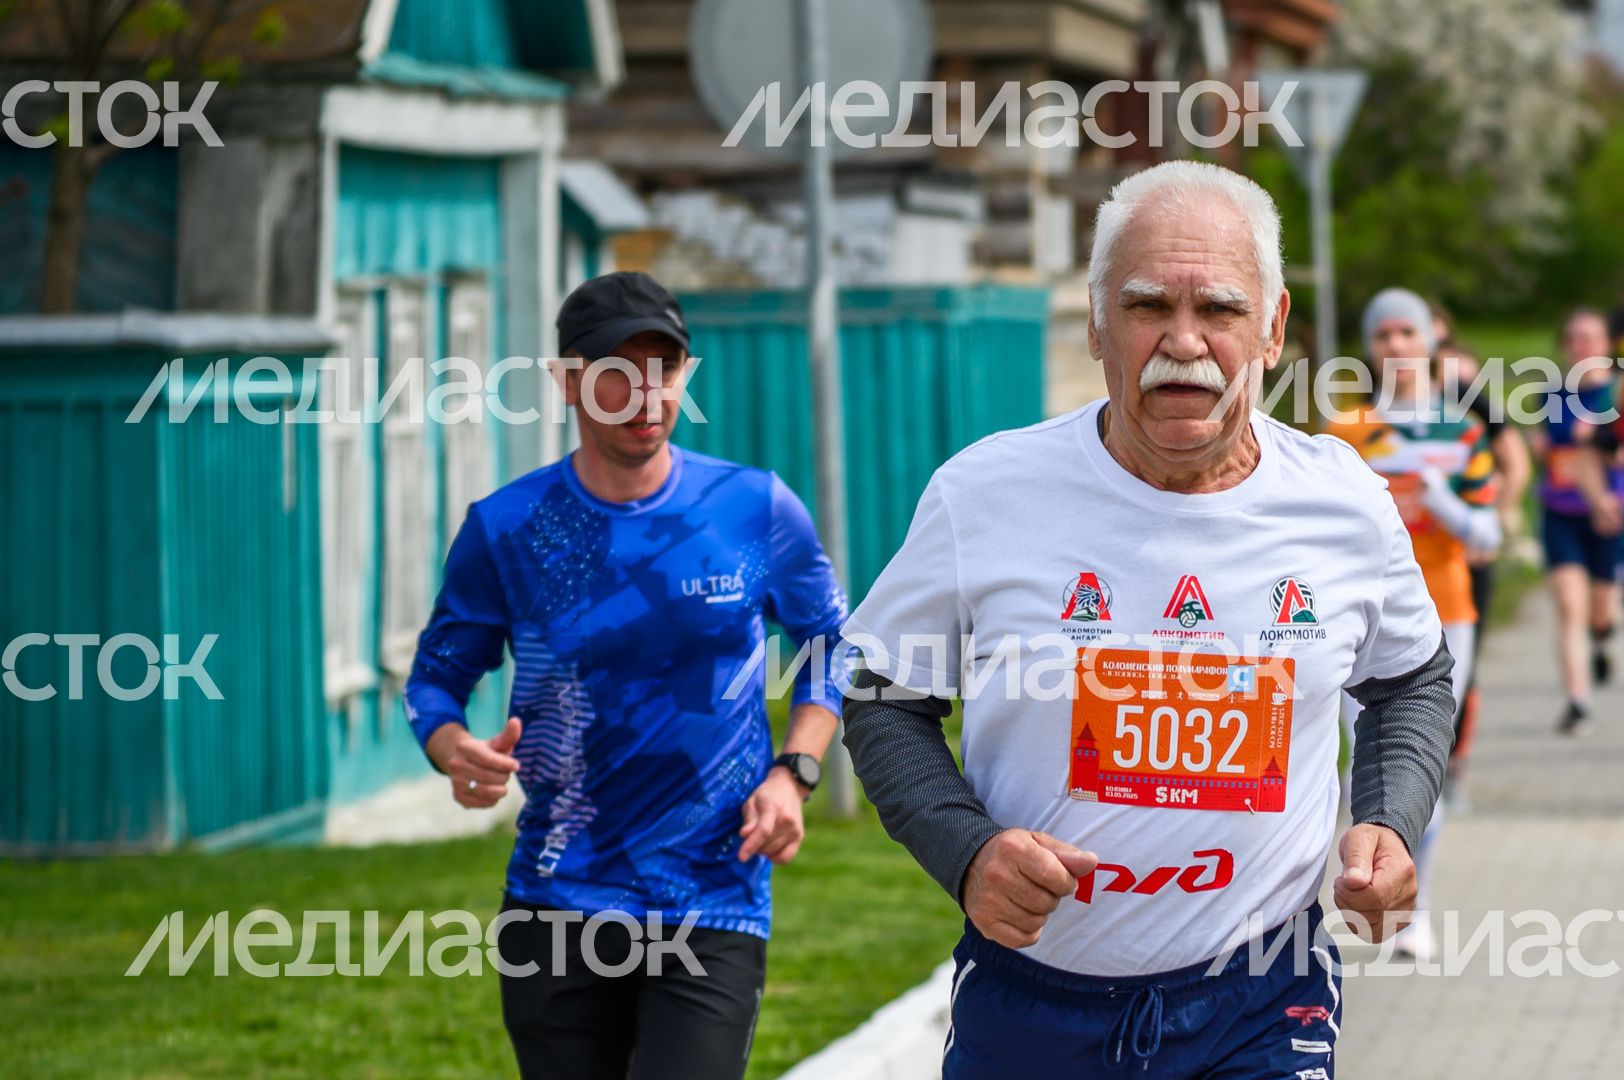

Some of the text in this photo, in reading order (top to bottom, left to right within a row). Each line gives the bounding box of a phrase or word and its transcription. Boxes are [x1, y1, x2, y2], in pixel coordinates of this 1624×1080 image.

[681, 575, 745, 596] ULTRA
[1152, 629, 1225, 640] ЛОКОМОТИВ
[1259, 629, 1327, 641] ЛОКОМОТИВ
[1112, 704, 1249, 774] 5032
